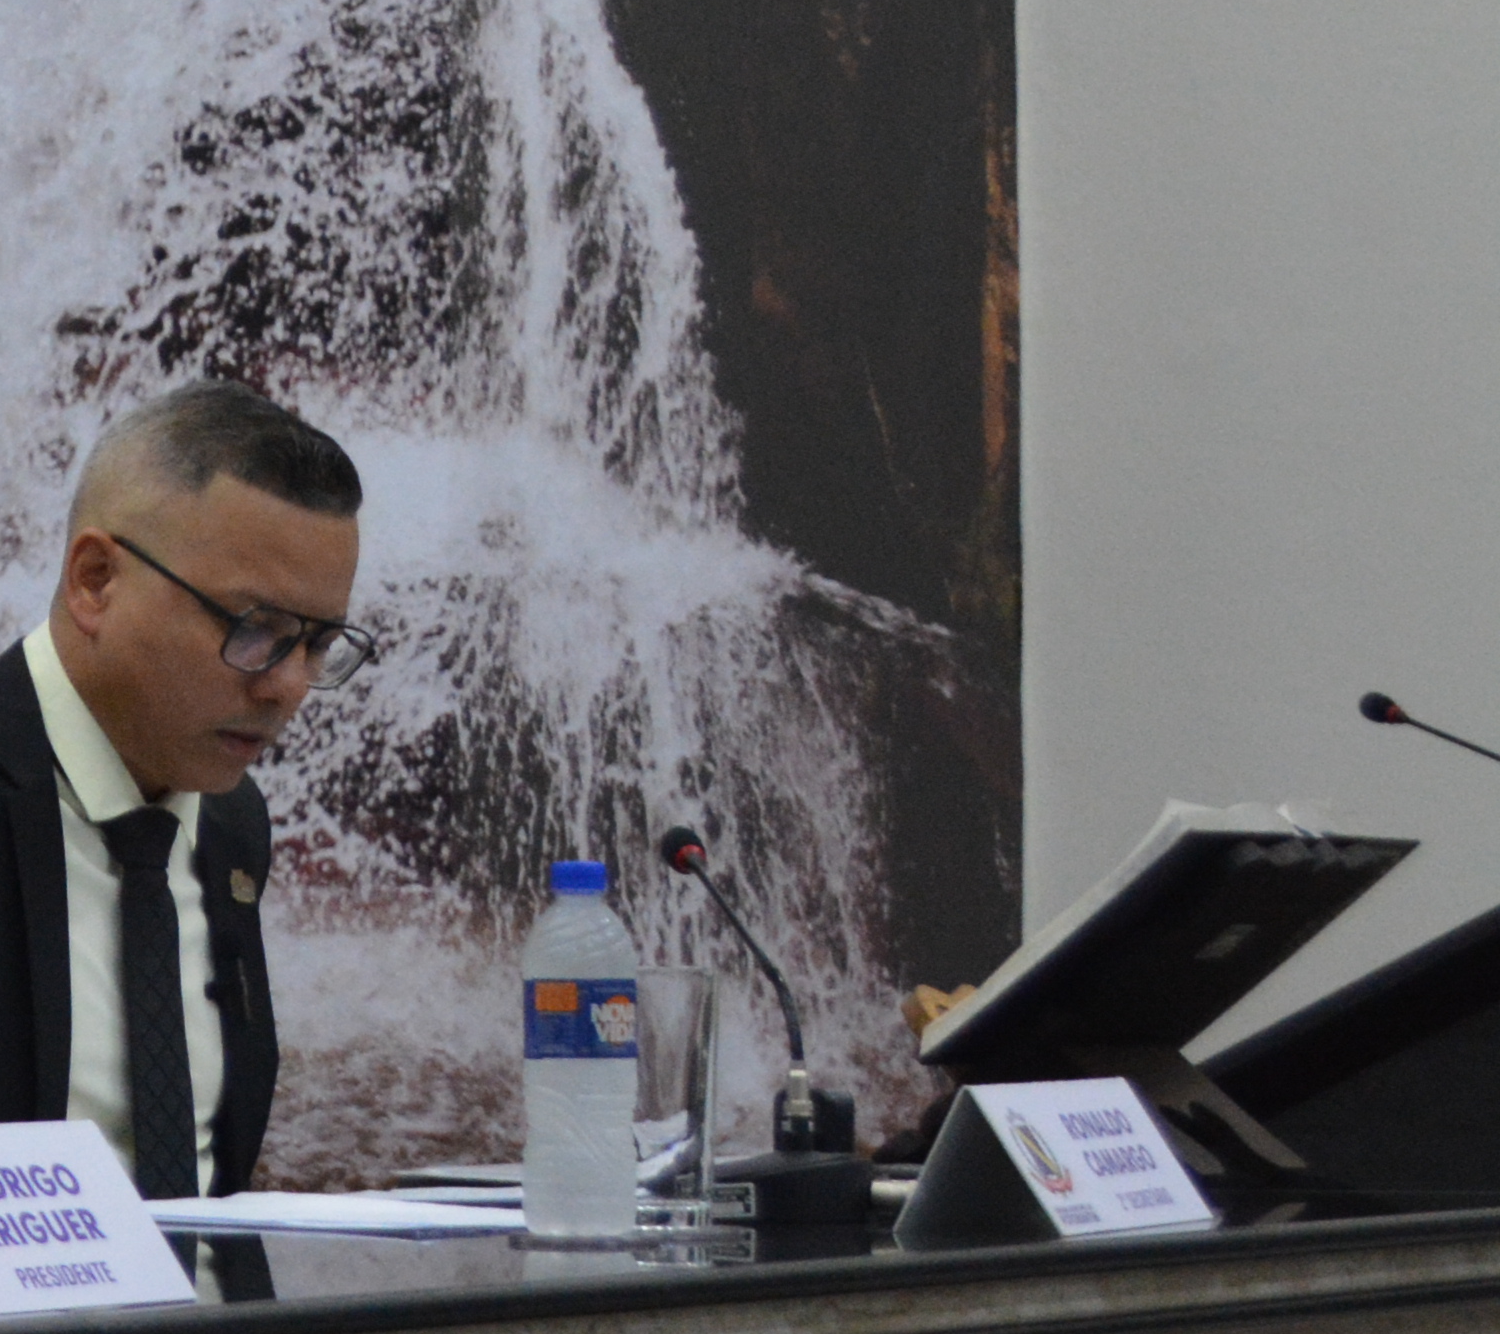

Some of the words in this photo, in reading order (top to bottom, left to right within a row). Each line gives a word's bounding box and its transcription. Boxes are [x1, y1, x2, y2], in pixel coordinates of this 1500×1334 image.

[1058, 1108, 1134, 1140] RONALDO
[1082, 1144, 1157, 1177] CAMARGO
[14, 1260, 118, 1290] PRESIDENTE
